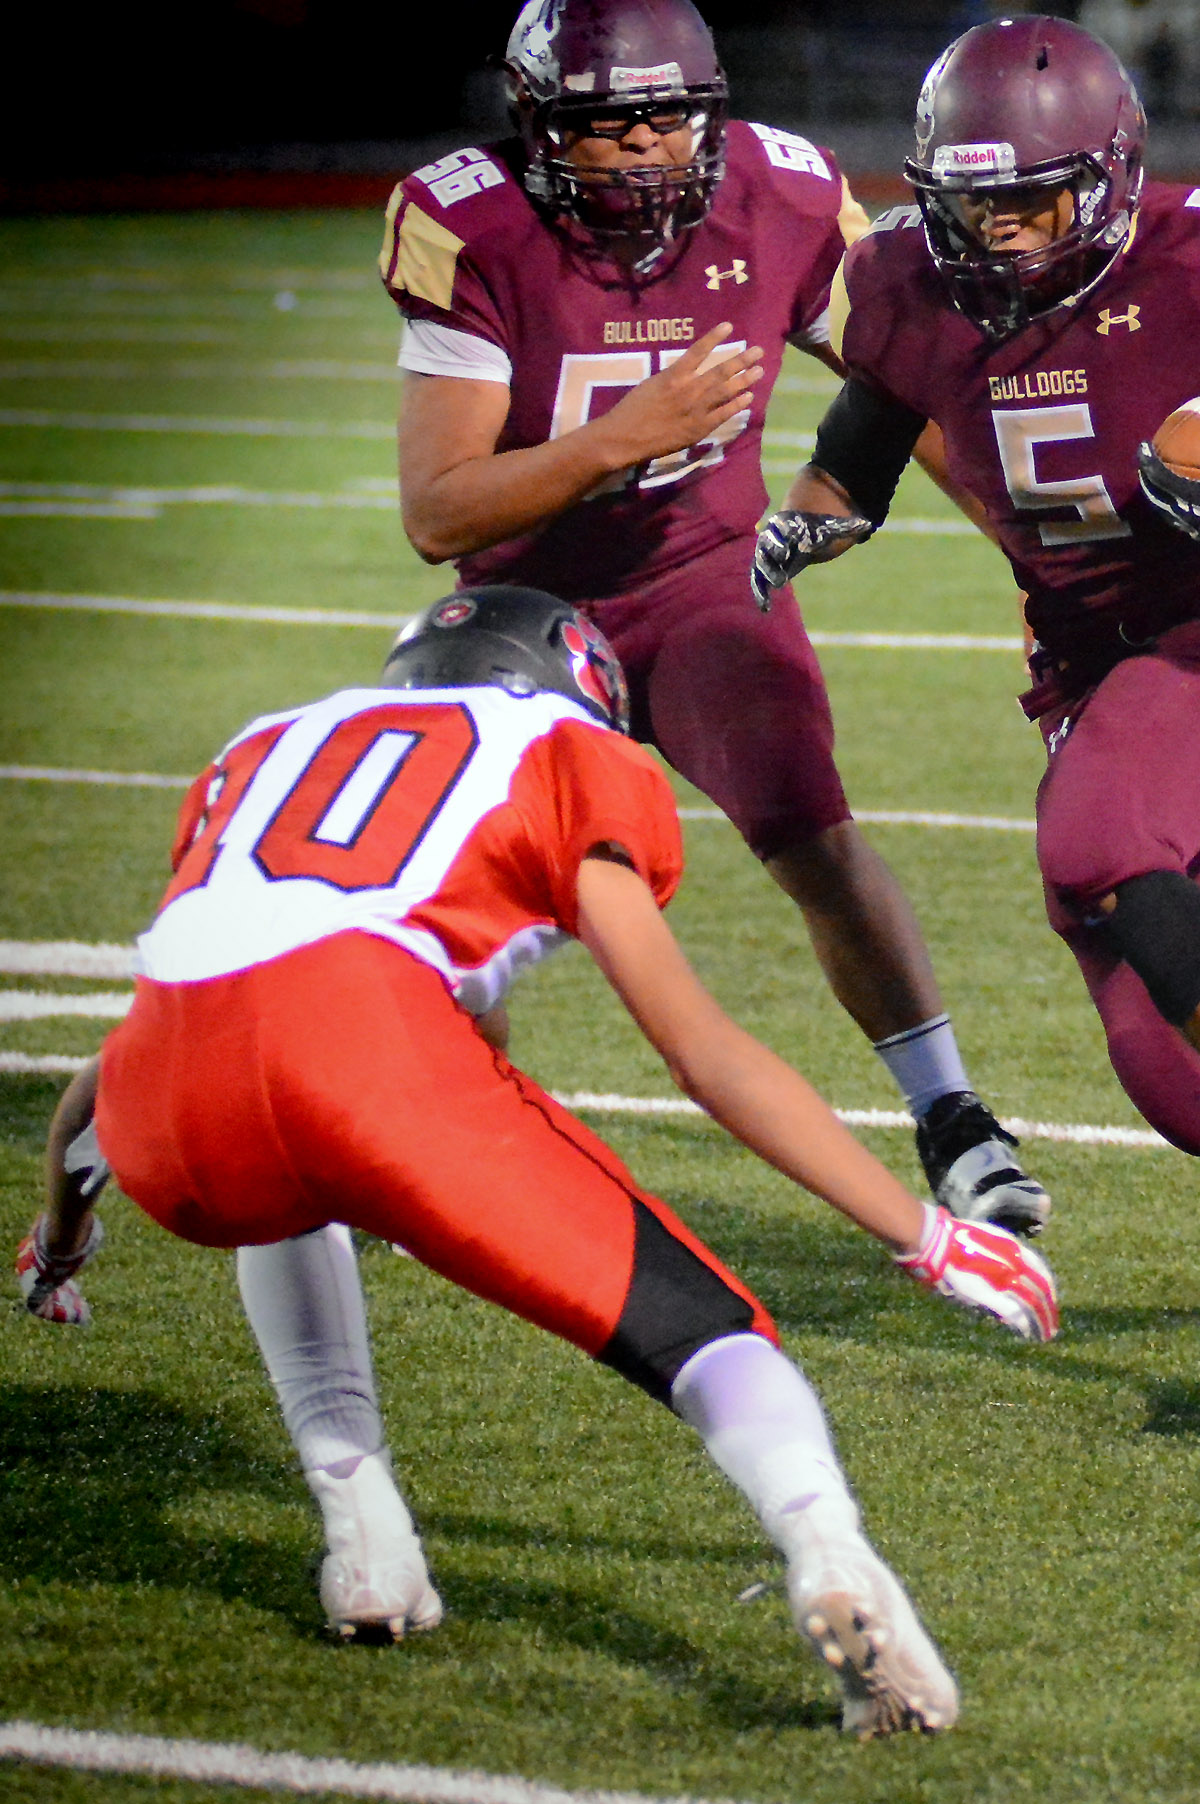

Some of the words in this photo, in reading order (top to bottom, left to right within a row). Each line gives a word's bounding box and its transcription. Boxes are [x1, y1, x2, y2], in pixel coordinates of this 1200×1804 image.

[953, 148, 997, 165] Riddell
[412, 147, 506, 209] 56
[603, 317, 695, 344] BULLDOGS
[988, 368, 1089, 401] BULLDOGS
[991, 402, 1134, 547] 5
